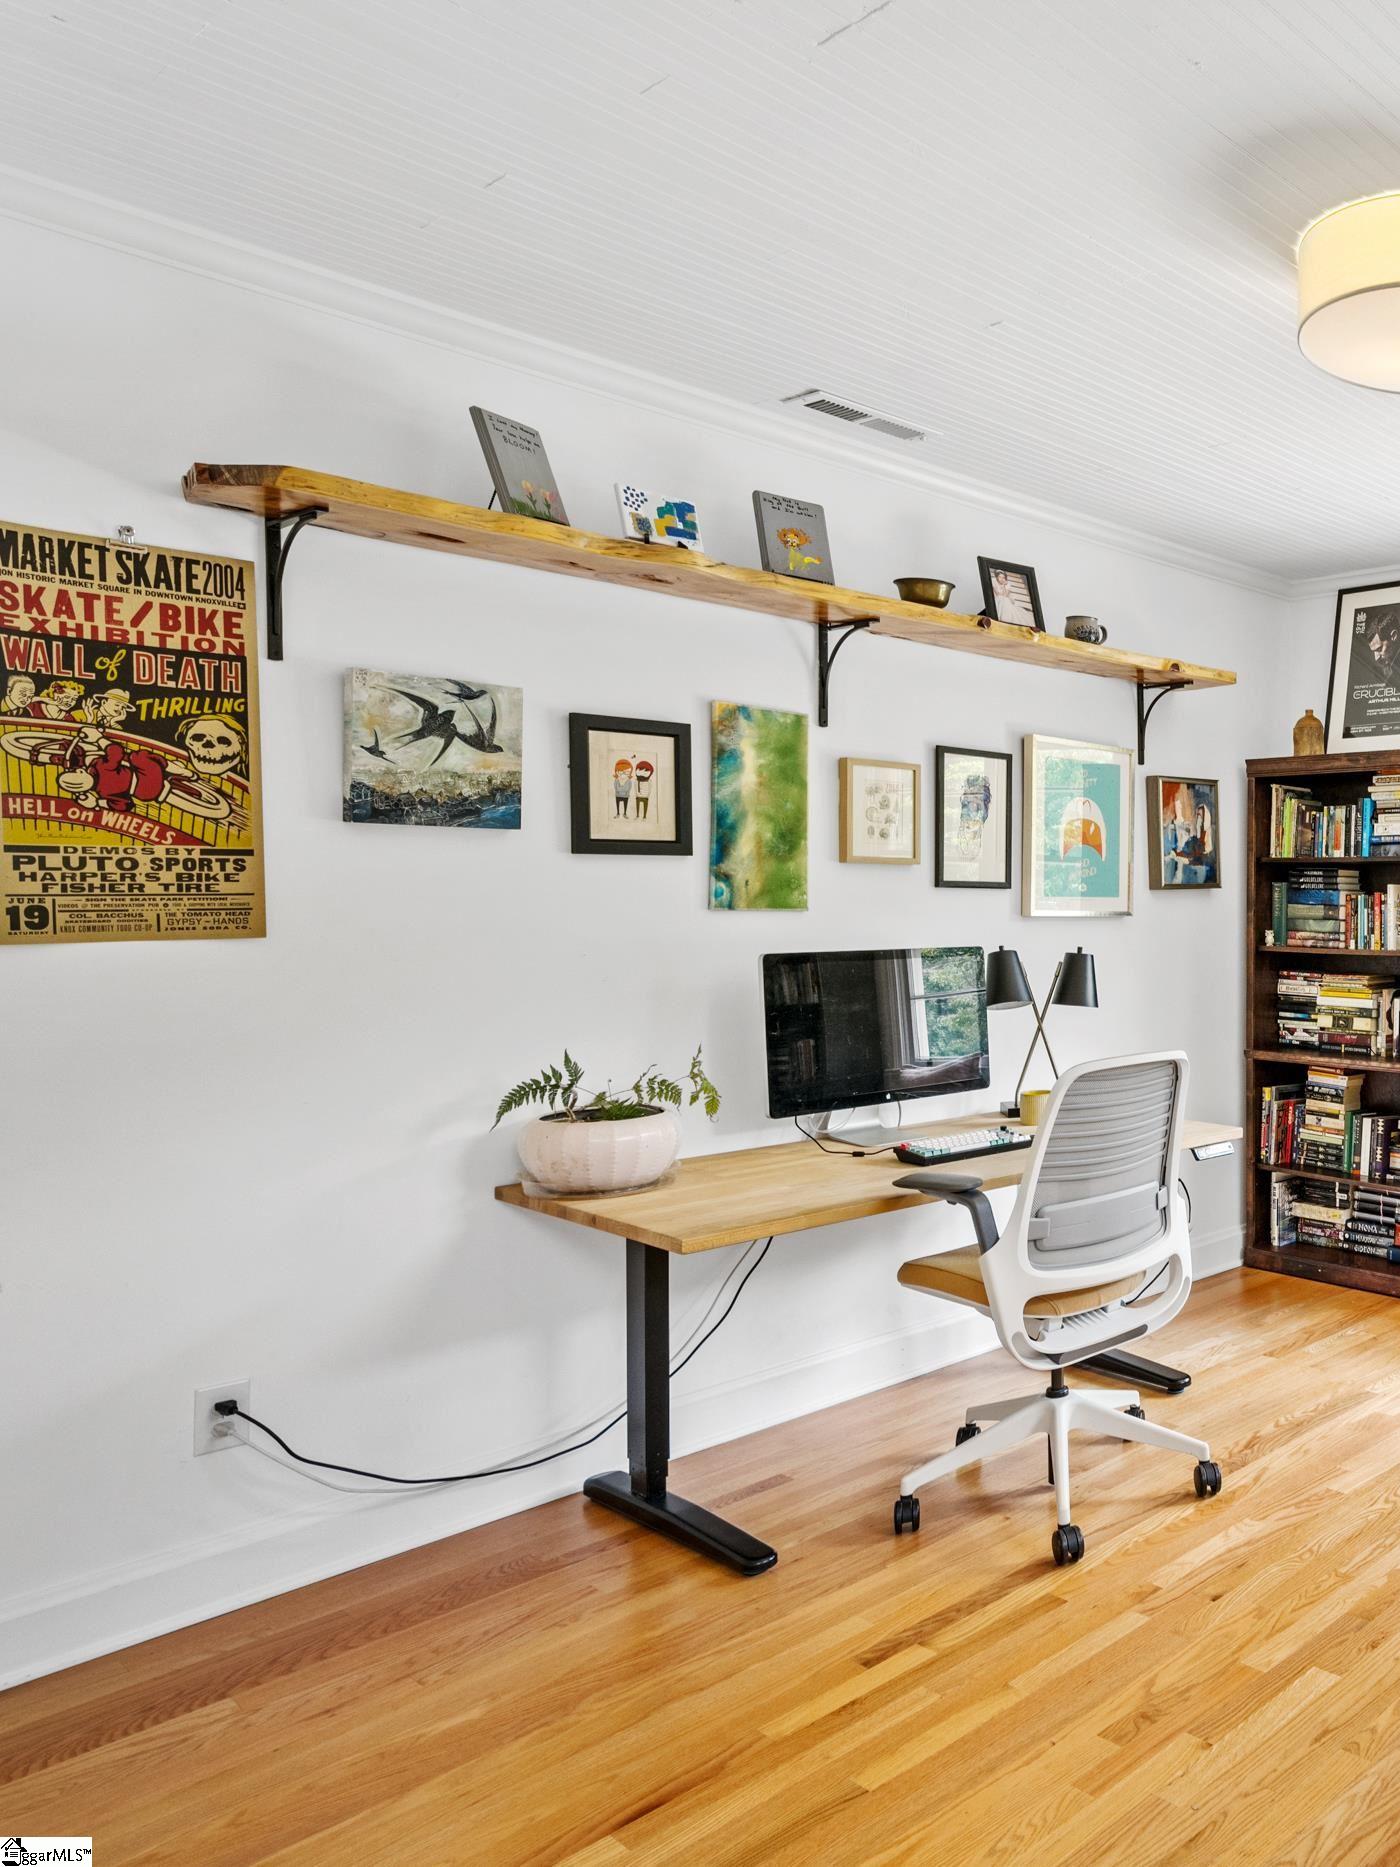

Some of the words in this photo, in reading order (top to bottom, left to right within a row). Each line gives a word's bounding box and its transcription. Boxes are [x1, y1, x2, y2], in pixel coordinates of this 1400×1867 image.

[0, 528, 110, 582] MARKET
[116, 550, 200, 595] SKATE
[202, 560, 246, 601] 2004
[16, 571, 56, 583] HISTORIC
[59, 578, 94, 589] MARKET
[97, 583, 130, 594] SQUARE
[145, 591, 193, 602] DOWNTOWN
[195, 597, 237, 608] KNOXVILLE
[0, 613, 245, 656] EXHIBITION
[0, 634, 95, 679] WALL
[95, 648, 126, 681] of
[133, 650, 242, 694] DEATH
[136, 697, 245, 721] THRILLING
[8, 798, 63, 818] HELL
[68, 806, 93, 822] on
[100, 811, 176, 845] WHEELS
[63, 846, 155, 856] DEMOS
[165, 848, 194, 856] BY
[13, 856, 141, 871] PLUTO
[150, 857, 246, 872] SPORTS
[19, 871, 161, 882] HARPER'S
[175, 872, 240, 882] BIKE
[41, 882, 146, 893] FISHER
[158, 883, 220, 892] TIRE
[6, 905, 50, 931] 19
[167, 918, 202, 926] GYPSY
